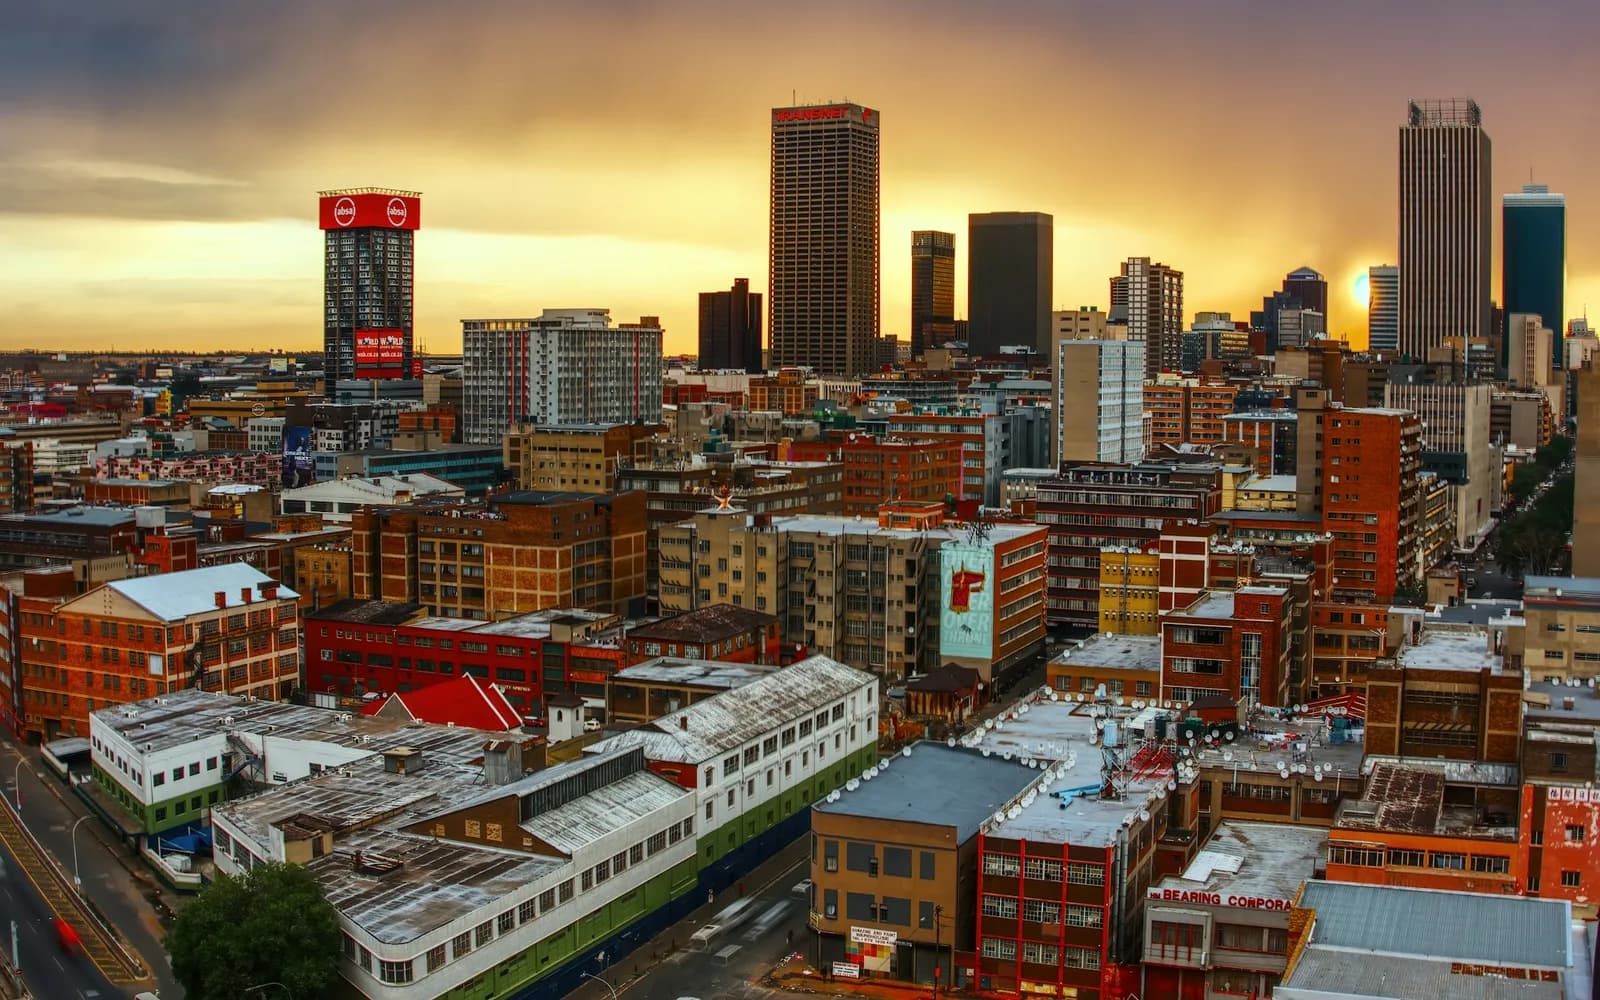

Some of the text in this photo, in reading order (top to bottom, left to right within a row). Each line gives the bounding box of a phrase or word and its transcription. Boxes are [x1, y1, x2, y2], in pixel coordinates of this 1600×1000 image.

[775, 107, 848, 122] TRANSNET
[337, 207, 353, 216] absa
[389, 206, 405, 216] absa
[1163, 889, 1221, 905] BEARING
